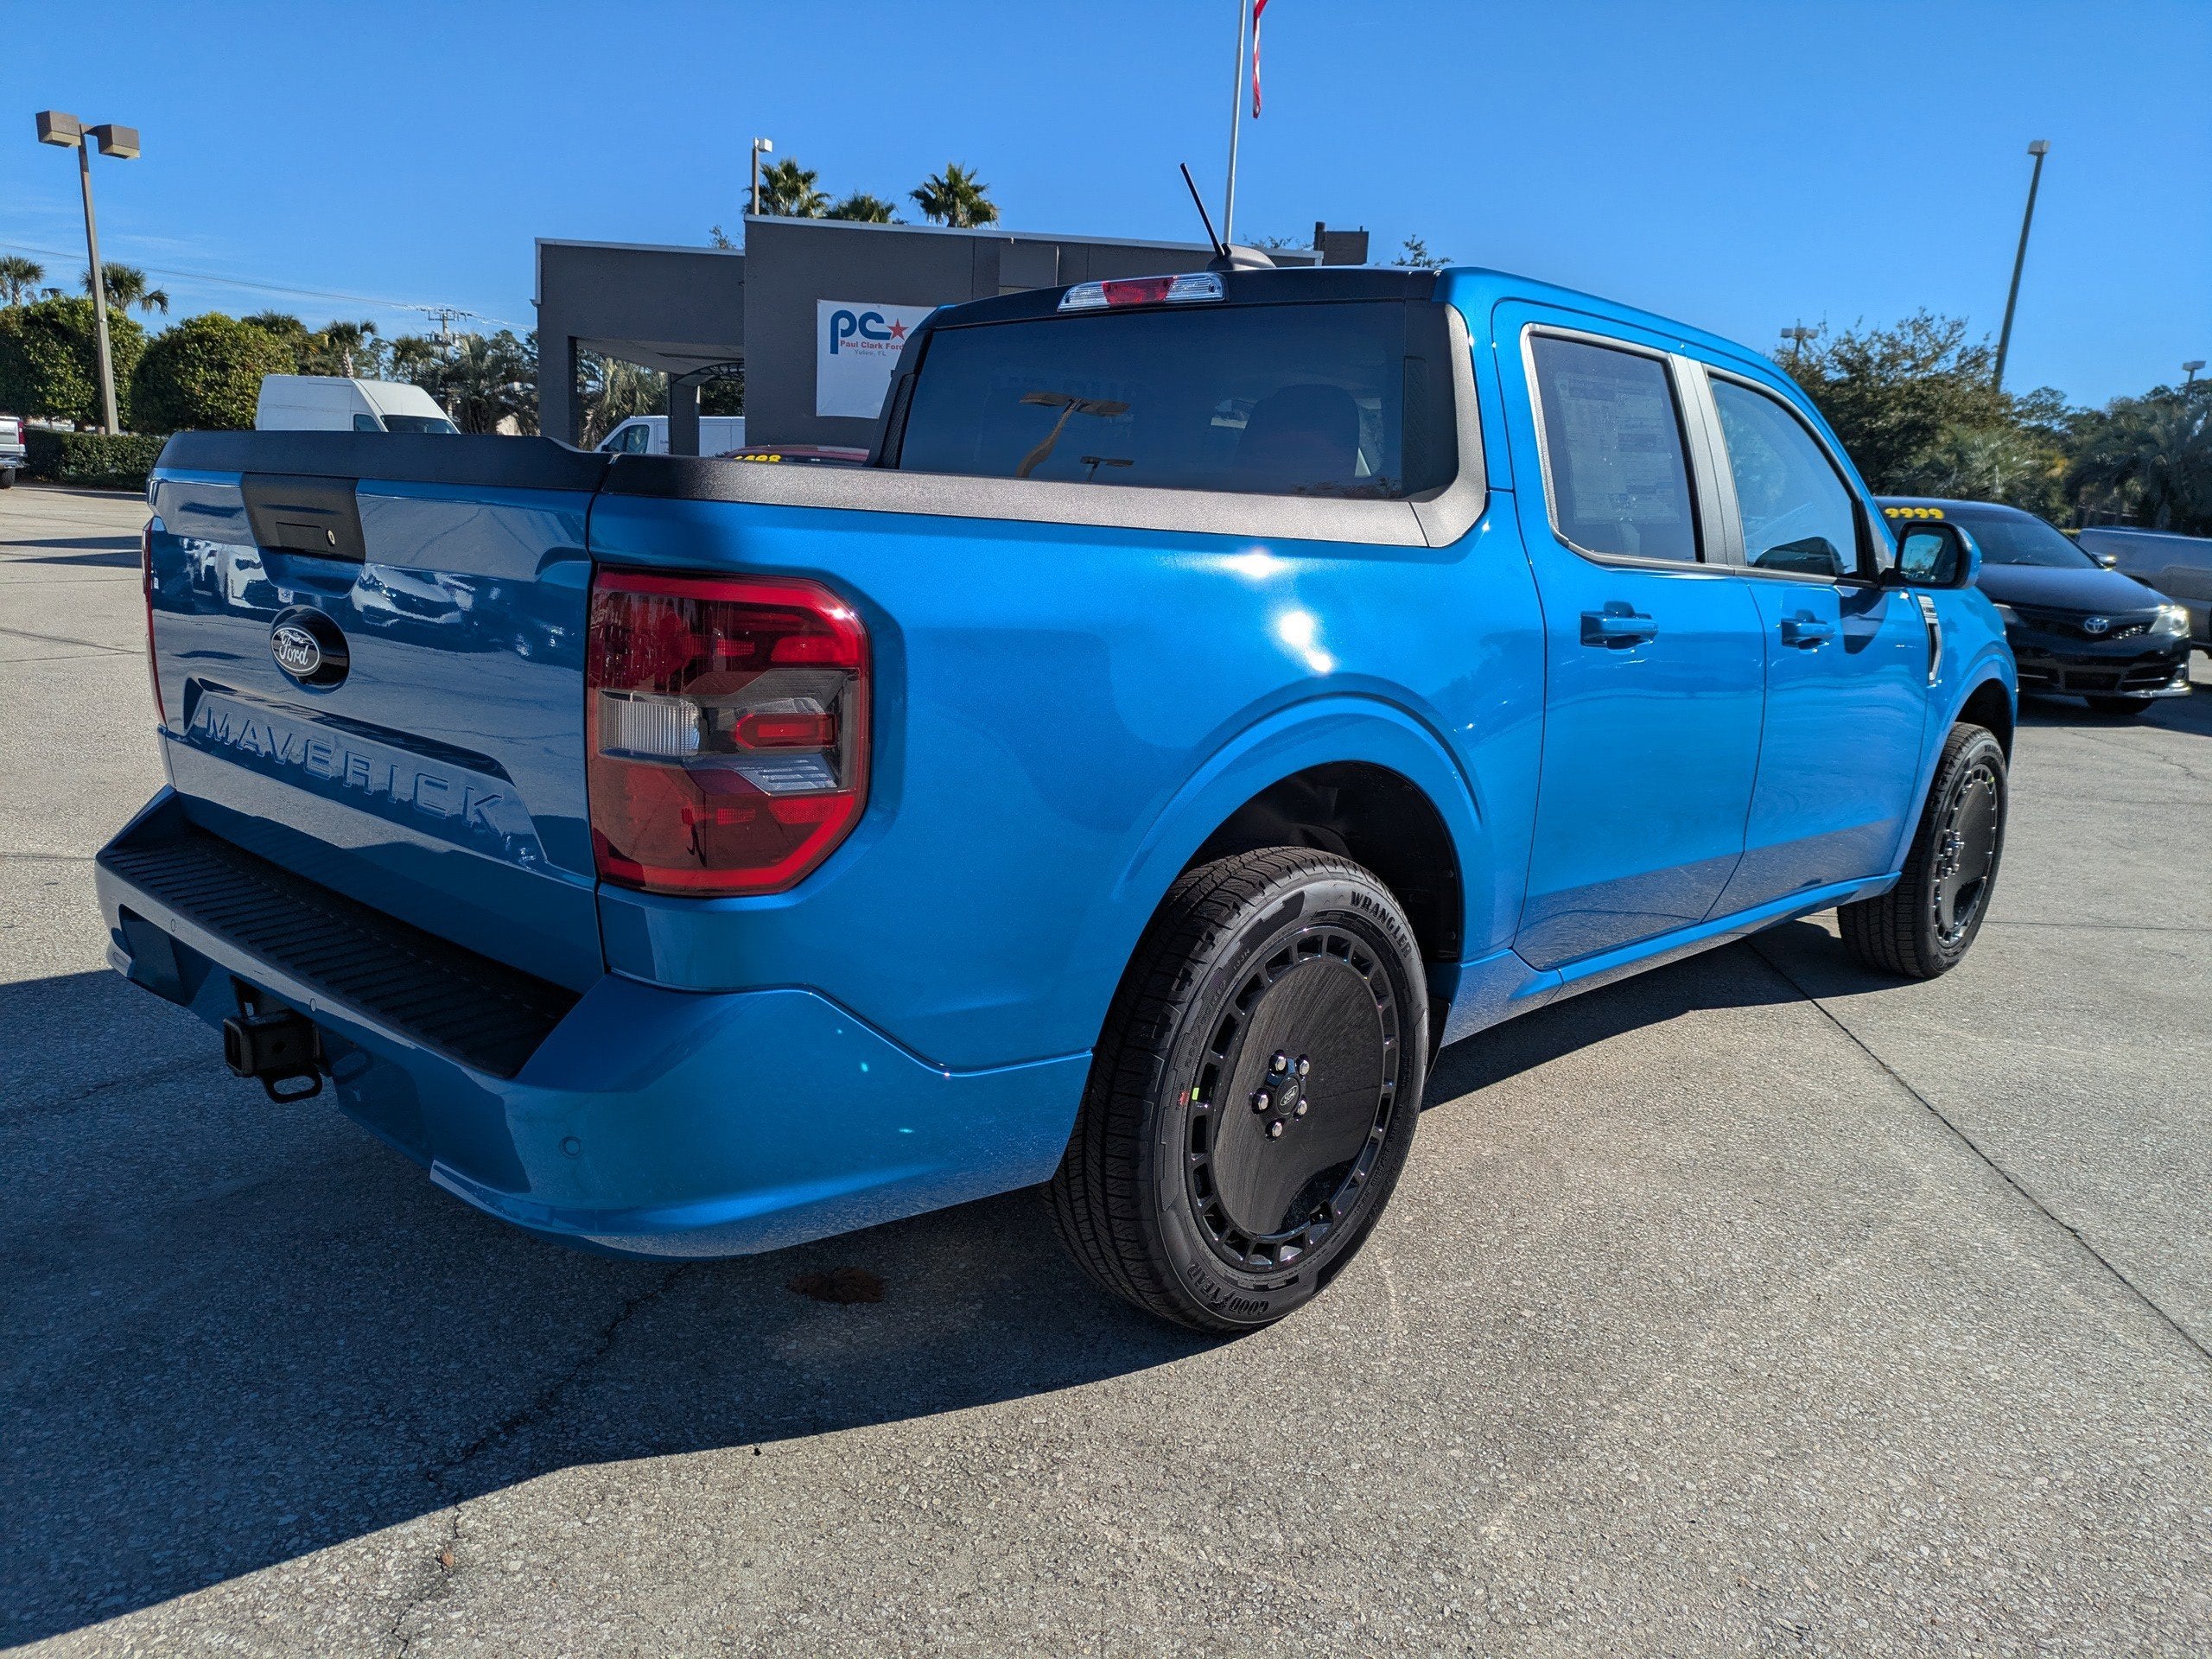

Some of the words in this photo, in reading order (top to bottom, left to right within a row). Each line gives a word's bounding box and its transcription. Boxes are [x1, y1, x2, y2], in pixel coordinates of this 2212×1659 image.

[840, 340, 859, 348] Paul
[861, 341, 883, 350] Clark
[1885, 507, 1944, 520] 9999
[205, 705, 505, 837] MAVERICK
[1350, 890, 1413, 958] WRANGLER
[1185, 1261, 1269, 1316] GOODYEAR
